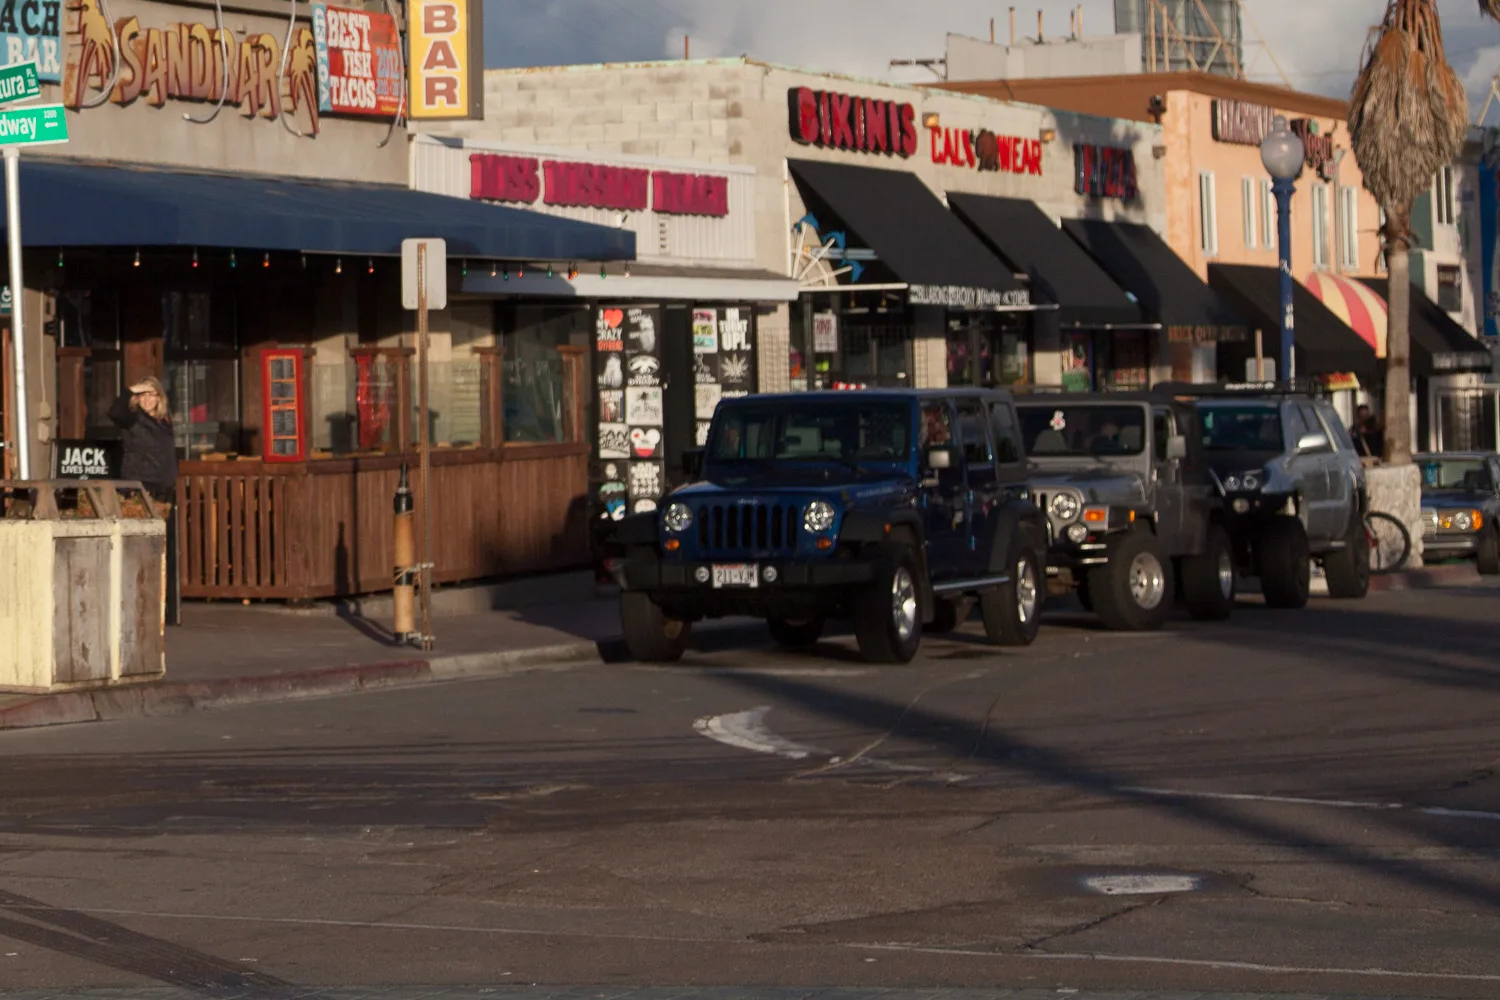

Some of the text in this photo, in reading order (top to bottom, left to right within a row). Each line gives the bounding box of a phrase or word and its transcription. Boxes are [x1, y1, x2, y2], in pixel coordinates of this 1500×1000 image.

[327, 9, 371, 51] BEST
[7, 34, 60, 74] BAR
[111, 15, 280, 118] SANDBAR
[342, 49, 373, 78] FISH
[330, 74, 377, 109] TACOS
[794, 86, 918, 156] BIKINIS
[996, 134, 1043, 176] WEAR
[61, 448, 106, 466] JACK
[61, 466, 83, 474] LIVES
